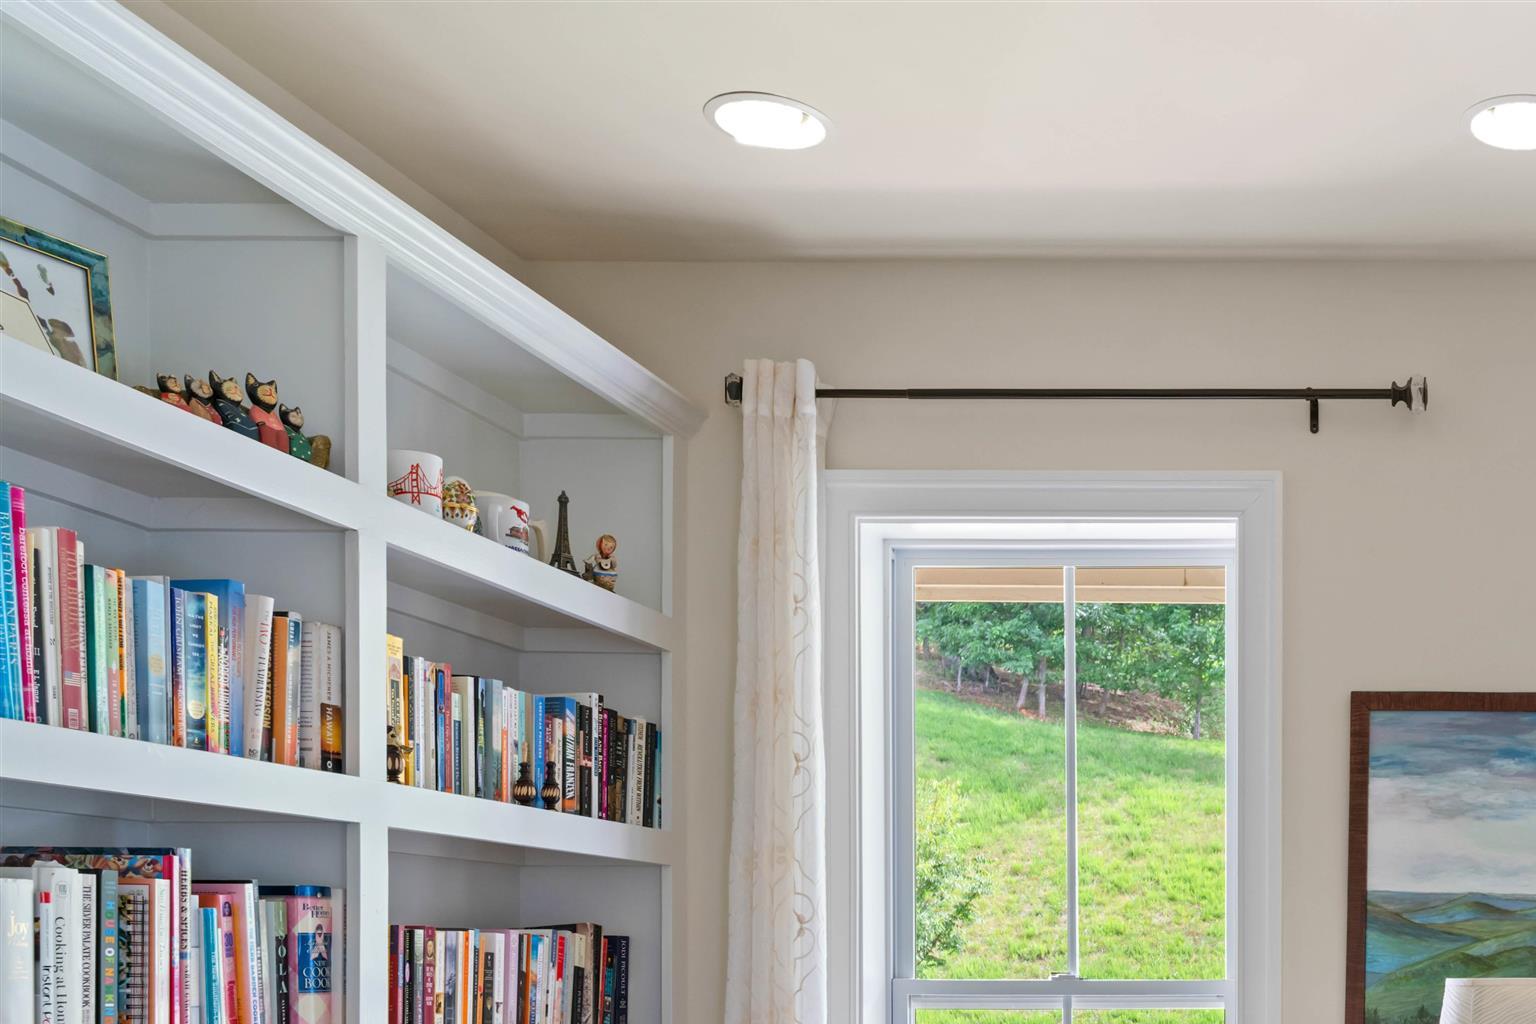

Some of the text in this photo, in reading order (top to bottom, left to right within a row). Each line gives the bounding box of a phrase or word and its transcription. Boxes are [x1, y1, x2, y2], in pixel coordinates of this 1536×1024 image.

[0, 512, 19, 665] BAREFOOT IN PARIS
[19, 527, 33, 674] barefoot contessa at home
[67, 550, 80, 652] TOM BROKAW
[175, 597, 183, 624] JOHN
[566, 763, 575, 799] FRANZEN
[82, 885, 92, 902] THE
[180, 870, 188, 903] HERBS
[82, 903, 92, 929] SILVER
[180, 917, 188, 950] SPICES
[53, 916, 66, 973] Cooking
[82, 931, 92, 961] PALATE
[104, 901, 115, 1024] HOUSE OF NANKING
[41, 965, 52, 1007] Instant
[56, 977, 65, 989] at
[82, 962, 92, 1008] COOKBOOK
